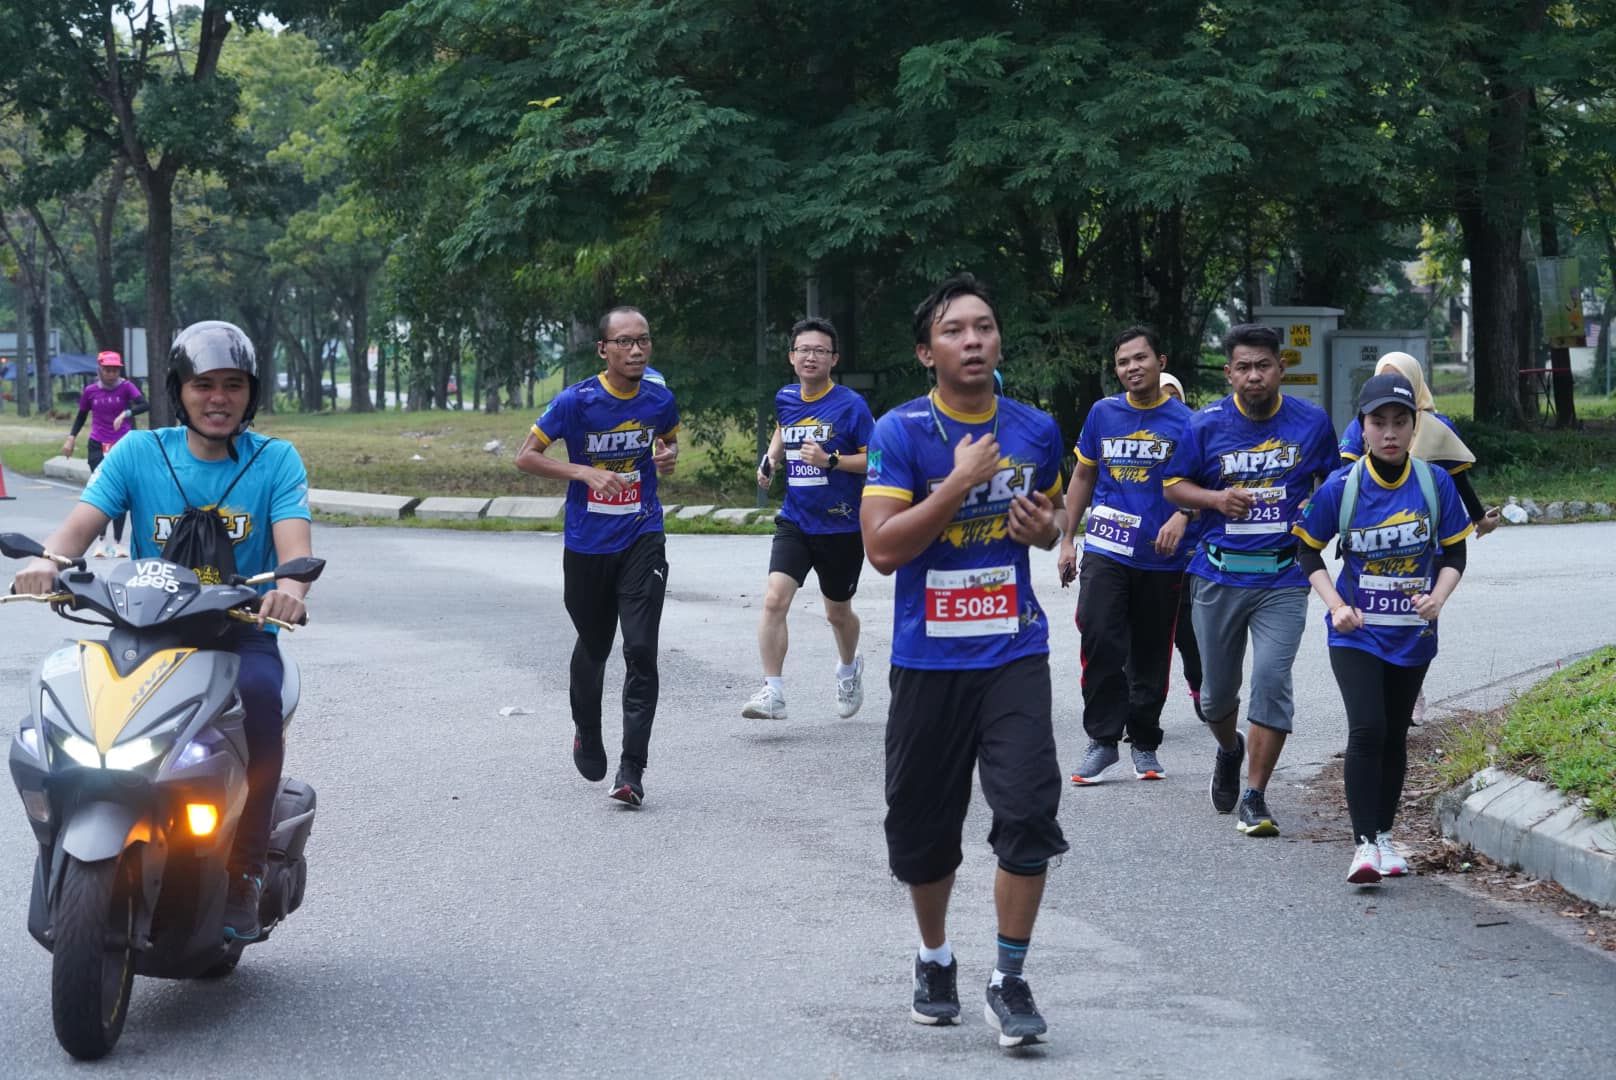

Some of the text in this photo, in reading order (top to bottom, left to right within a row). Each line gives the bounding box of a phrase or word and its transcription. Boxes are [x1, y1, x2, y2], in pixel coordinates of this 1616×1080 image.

[586, 429, 655, 453] MPKJ
[781, 425, 831, 443] MPKJ
[1102, 439, 1170, 460] MPKJ
[1221, 446, 1298, 475] MPKJ
[1099, 523, 1130, 543] 9213
[1350, 517, 1431, 553] MPKJ
[135, 561, 177, 579] VDE
[125, 575, 181, 594] 4995
[936, 595, 1009, 618] E 5082
[1366, 596, 1375, 611] J
